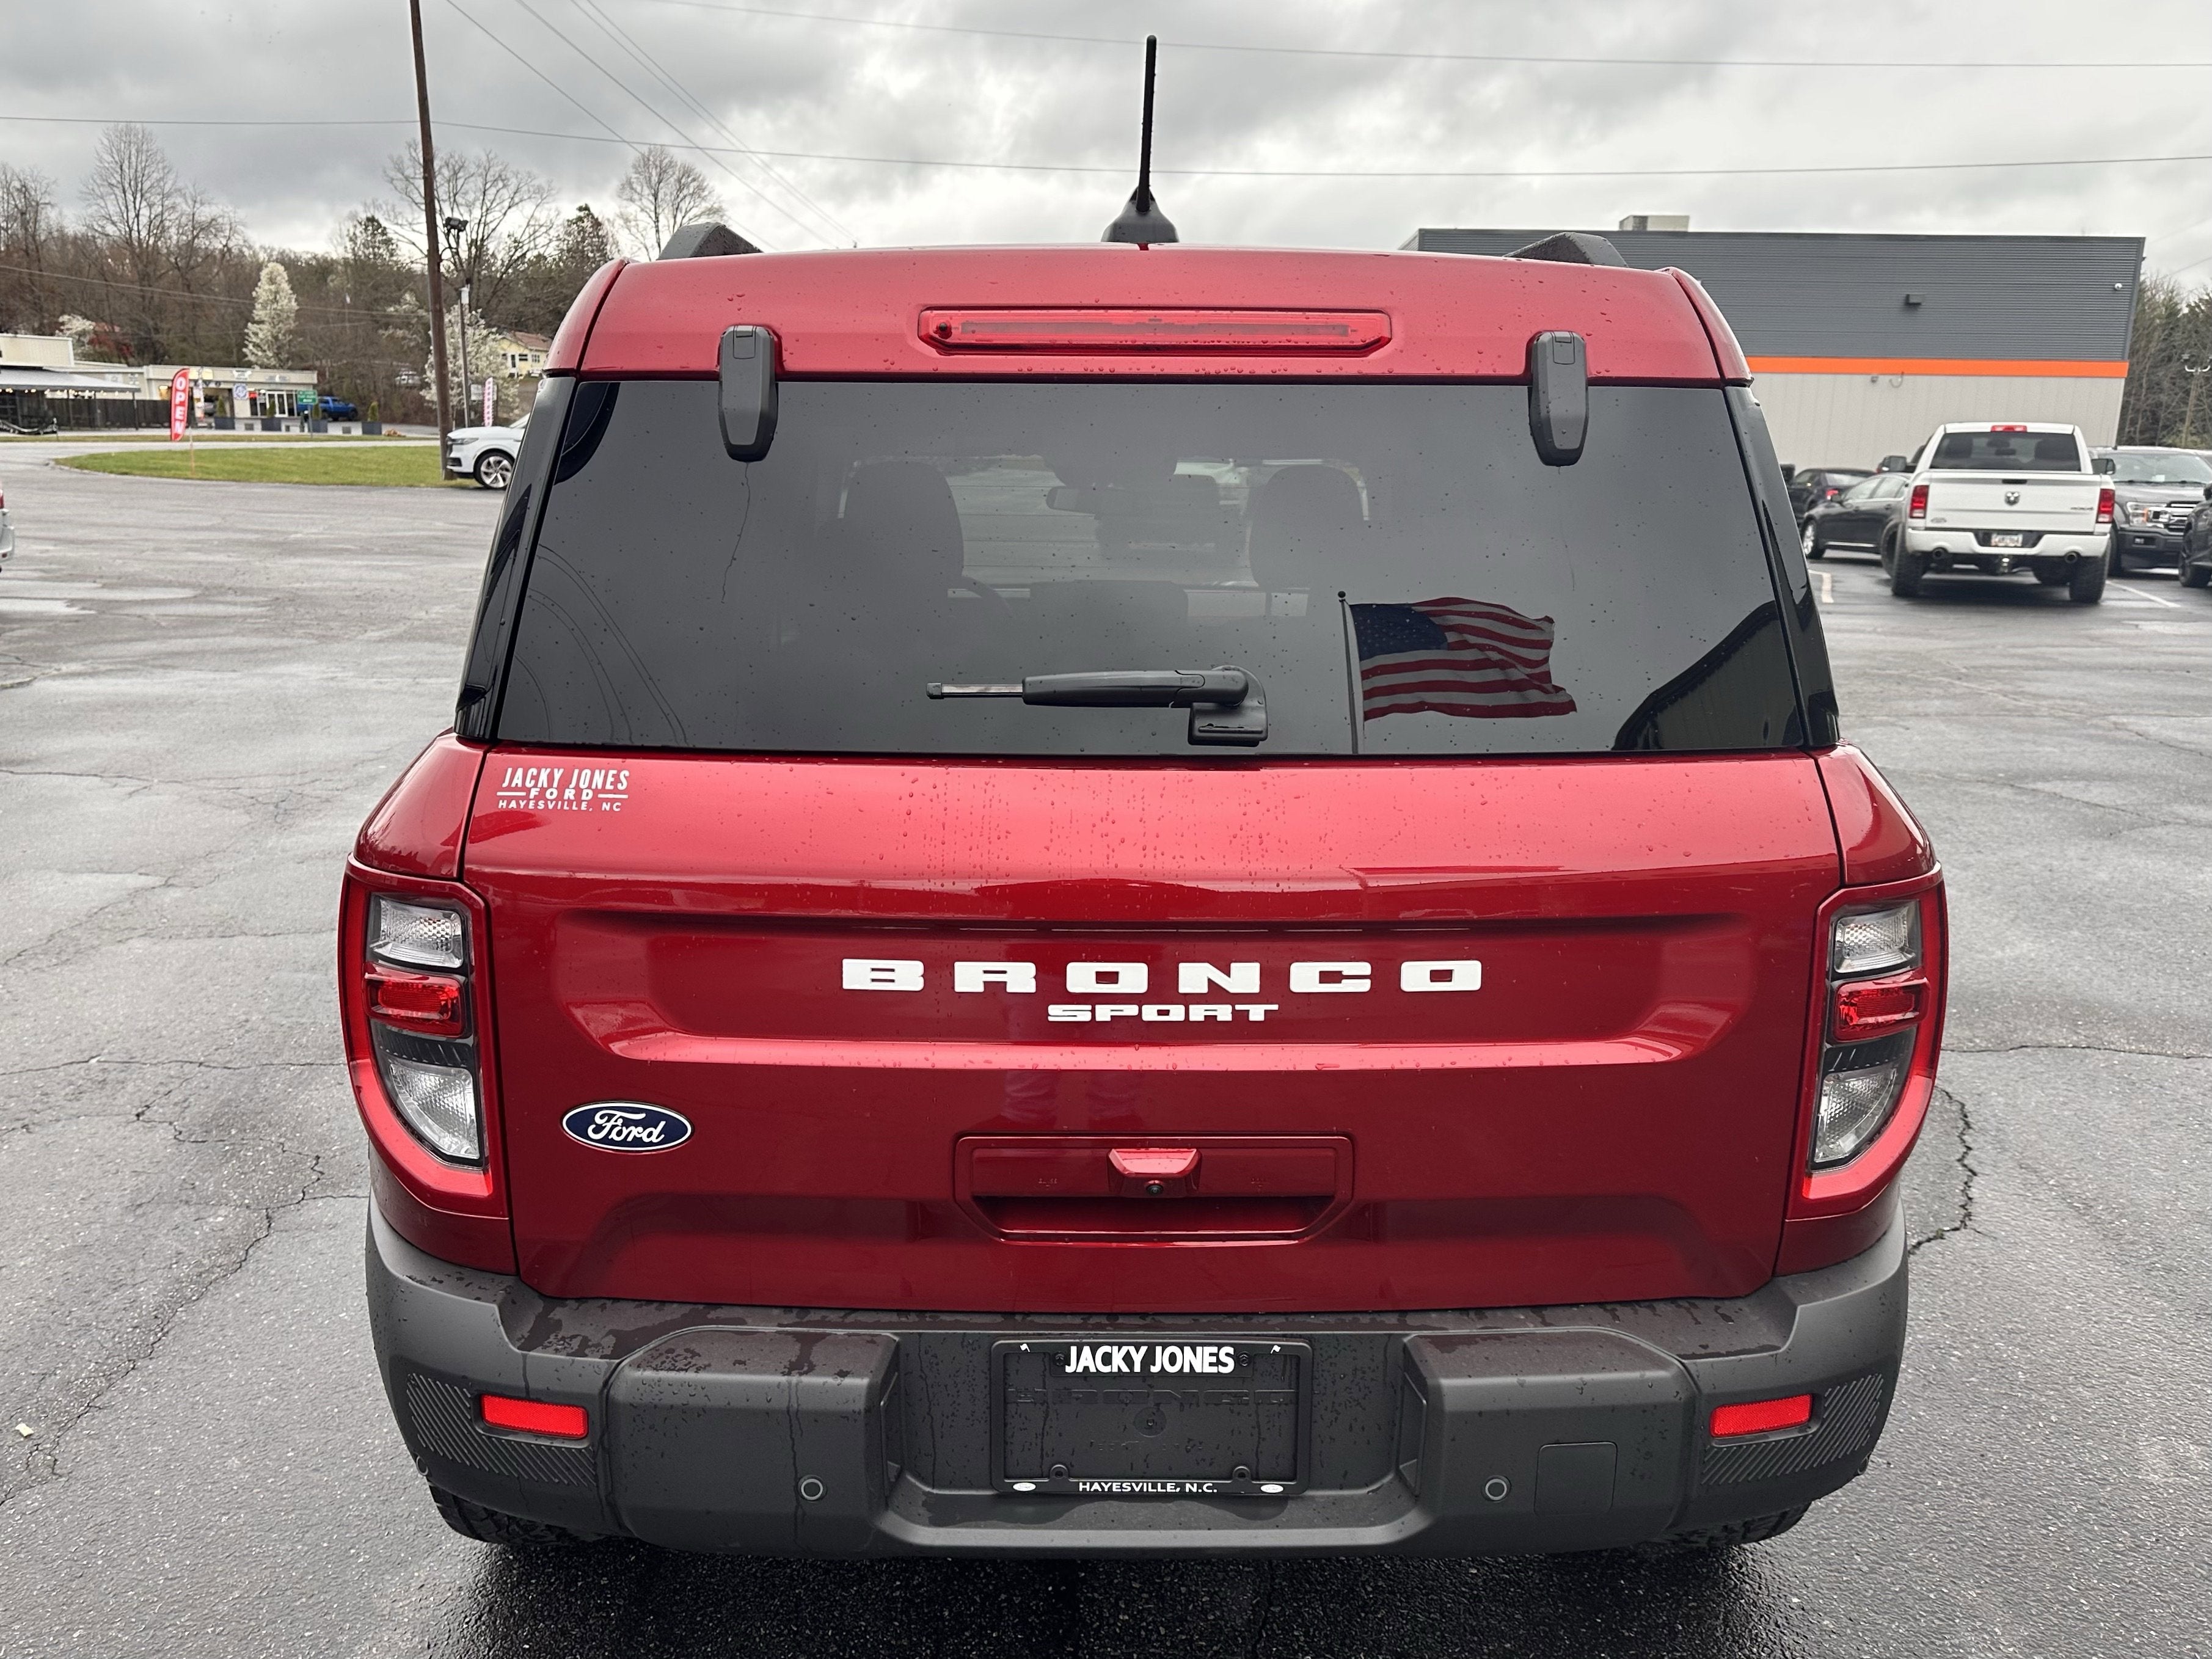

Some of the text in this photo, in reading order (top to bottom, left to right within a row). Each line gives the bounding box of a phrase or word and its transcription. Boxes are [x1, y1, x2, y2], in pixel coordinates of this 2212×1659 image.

[175, 377, 186, 434] OPEN
[502, 767, 630, 790] JACKY JONES
[529, 787, 594, 800] FORD
[498, 799, 622, 812] HAYESVILLE, NC
[842, 958, 1482, 994] BRONCO
[1048, 1004, 1279, 1022] SPORT
[587, 1109, 666, 1143] Ford
[1065, 1345, 1235, 1374] JACKY JONES
[1079, 1481, 1217, 1493] HAYESVILLE, N.C.
